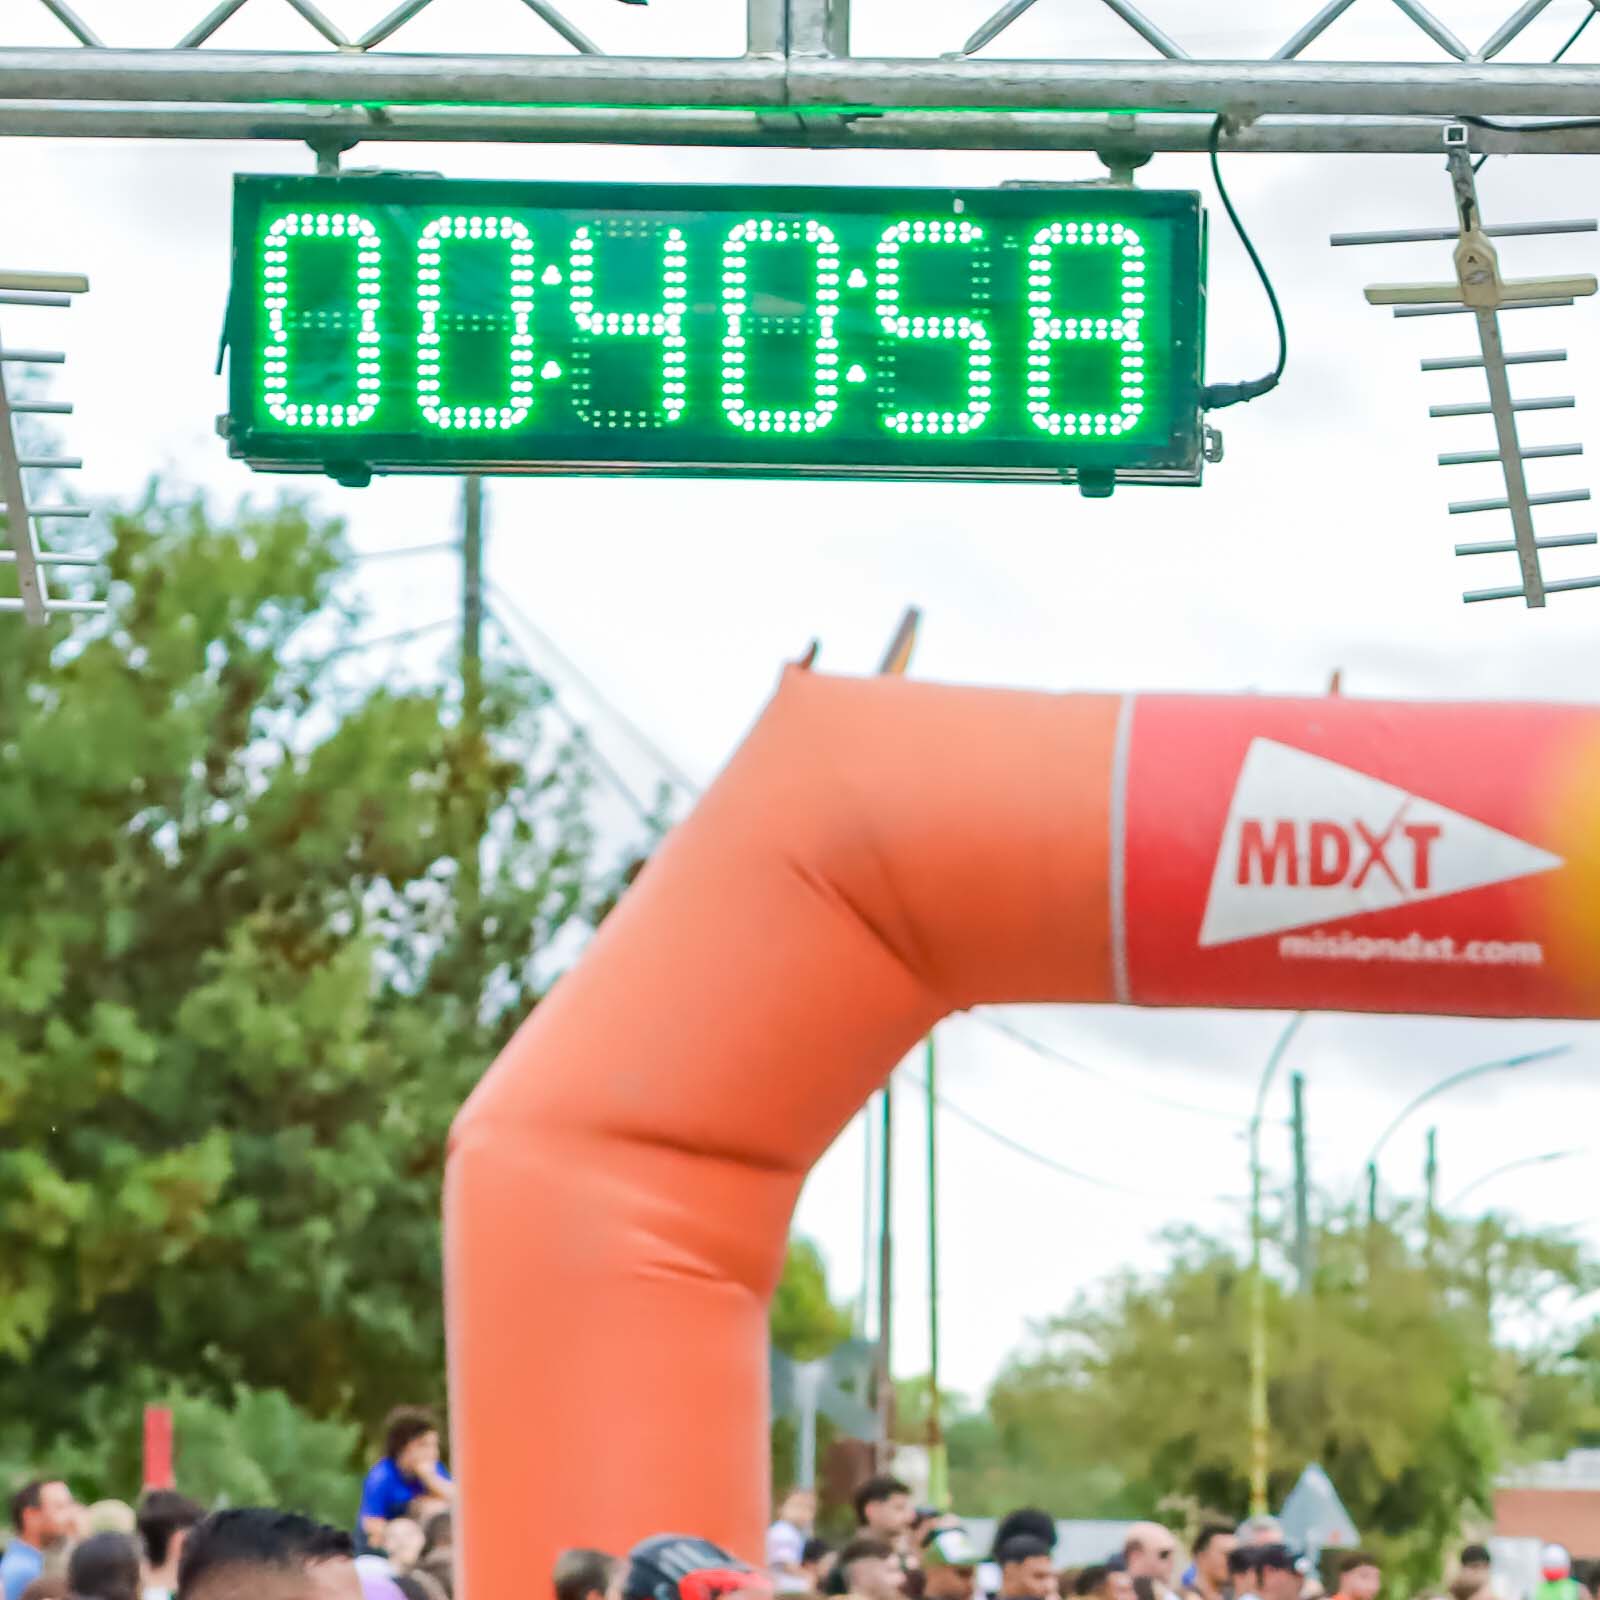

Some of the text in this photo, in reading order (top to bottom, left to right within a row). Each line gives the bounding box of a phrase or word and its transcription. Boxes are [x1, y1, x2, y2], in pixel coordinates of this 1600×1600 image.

[263, 212, 1146, 437] 00:40:58
[1237, 815, 1442, 892] MDXT
[1279, 929, 1543, 965] misiondxt.com
